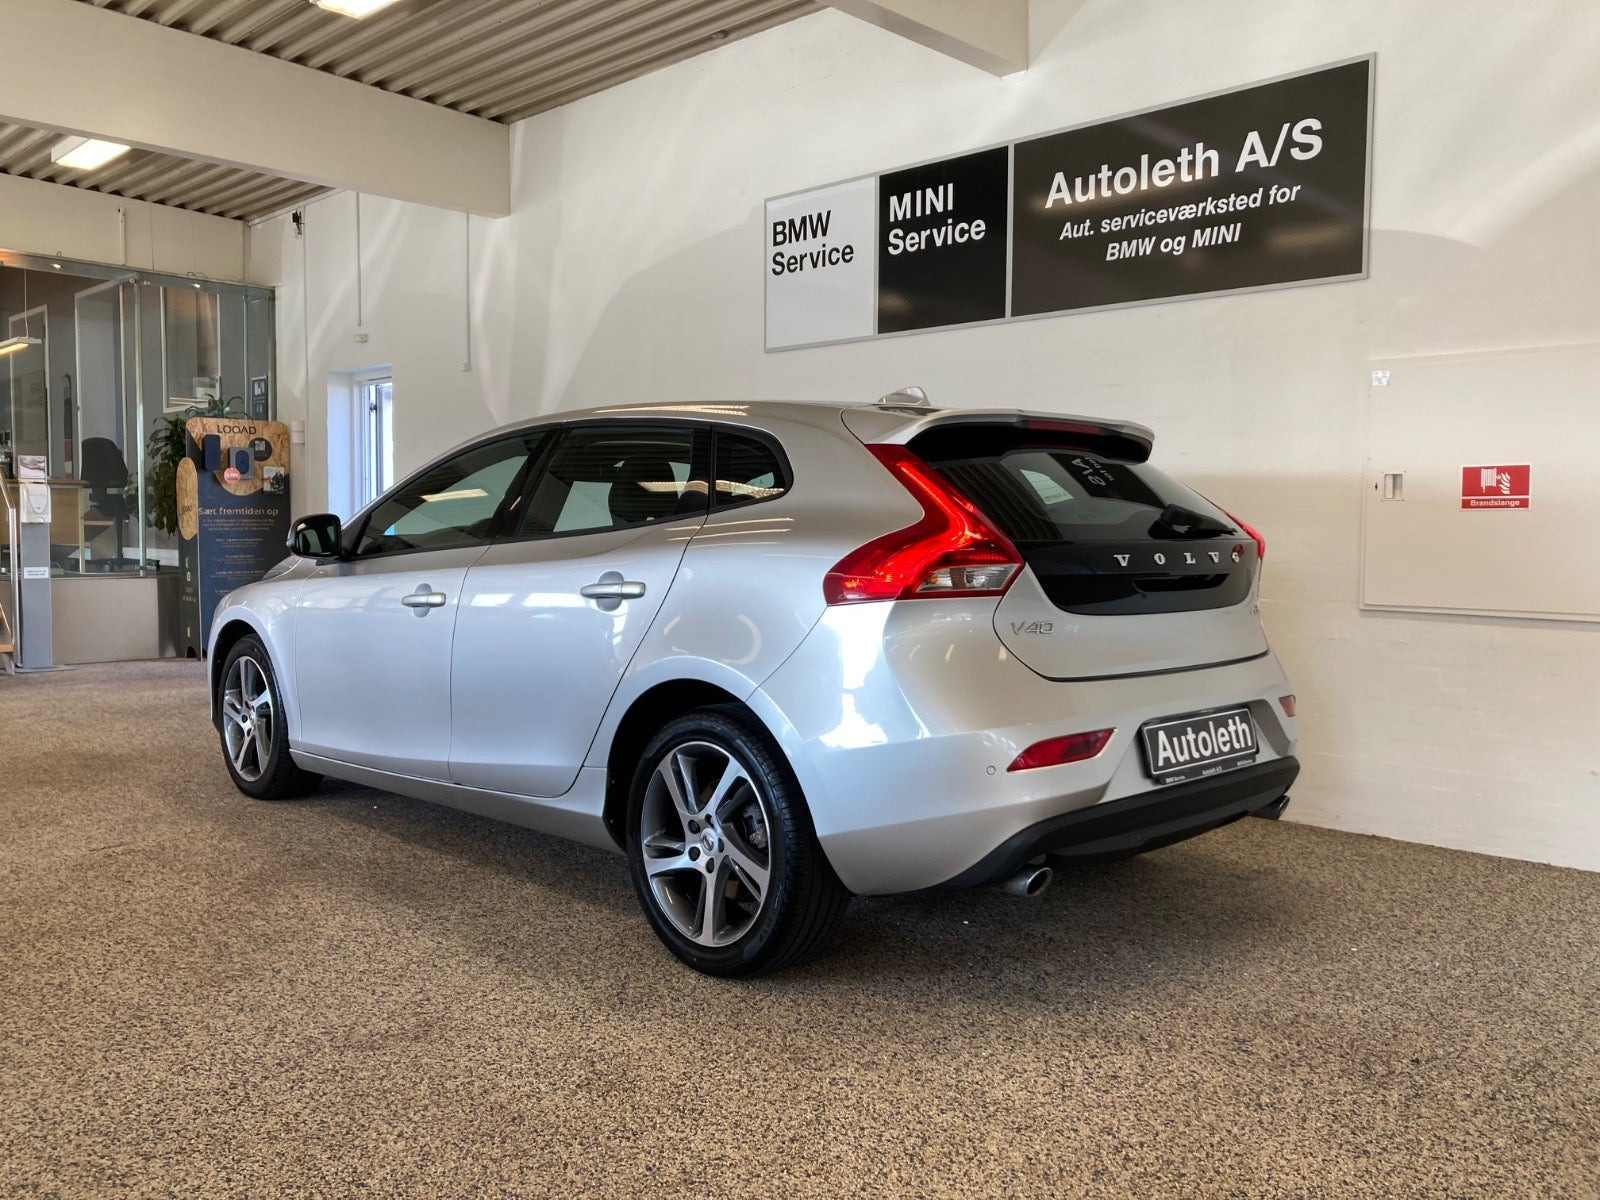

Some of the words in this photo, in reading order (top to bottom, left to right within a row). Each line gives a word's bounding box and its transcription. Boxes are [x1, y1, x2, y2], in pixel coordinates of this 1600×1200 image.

[1045, 142, 1219, 209] Autoleth
[1235, 117, 1323, 173] A/S
[889, 183, 954, 222] MINI
[1059, 218, 1095, 241] Aut.
[1100, 187, 1264, 234] serviceværksted
[1268, 184, 1301, 206] for
[772, 210, 832, 247] BMW
[887, 218, 986, 256] Service
[1106, 242, 1156, 261] BMW
[1160, 234, 1186, 256] og
[1191, 222, 1242, 248] MINI
[771, 243, 854, 276] Service
[217, 425, 257, 435] LOOAD
[198, 507, 217, 515] Sæt
[219, 506, 265, 516] fremtiden
[266, 508, 279, 517] op
[1469, 499, 1521, 507] Brandslange
[1112, 551, 1240, 567] VOLVO
[1010, 620, 1054, 636] V40
[1156, 716, 1252, 767] Autoleth
